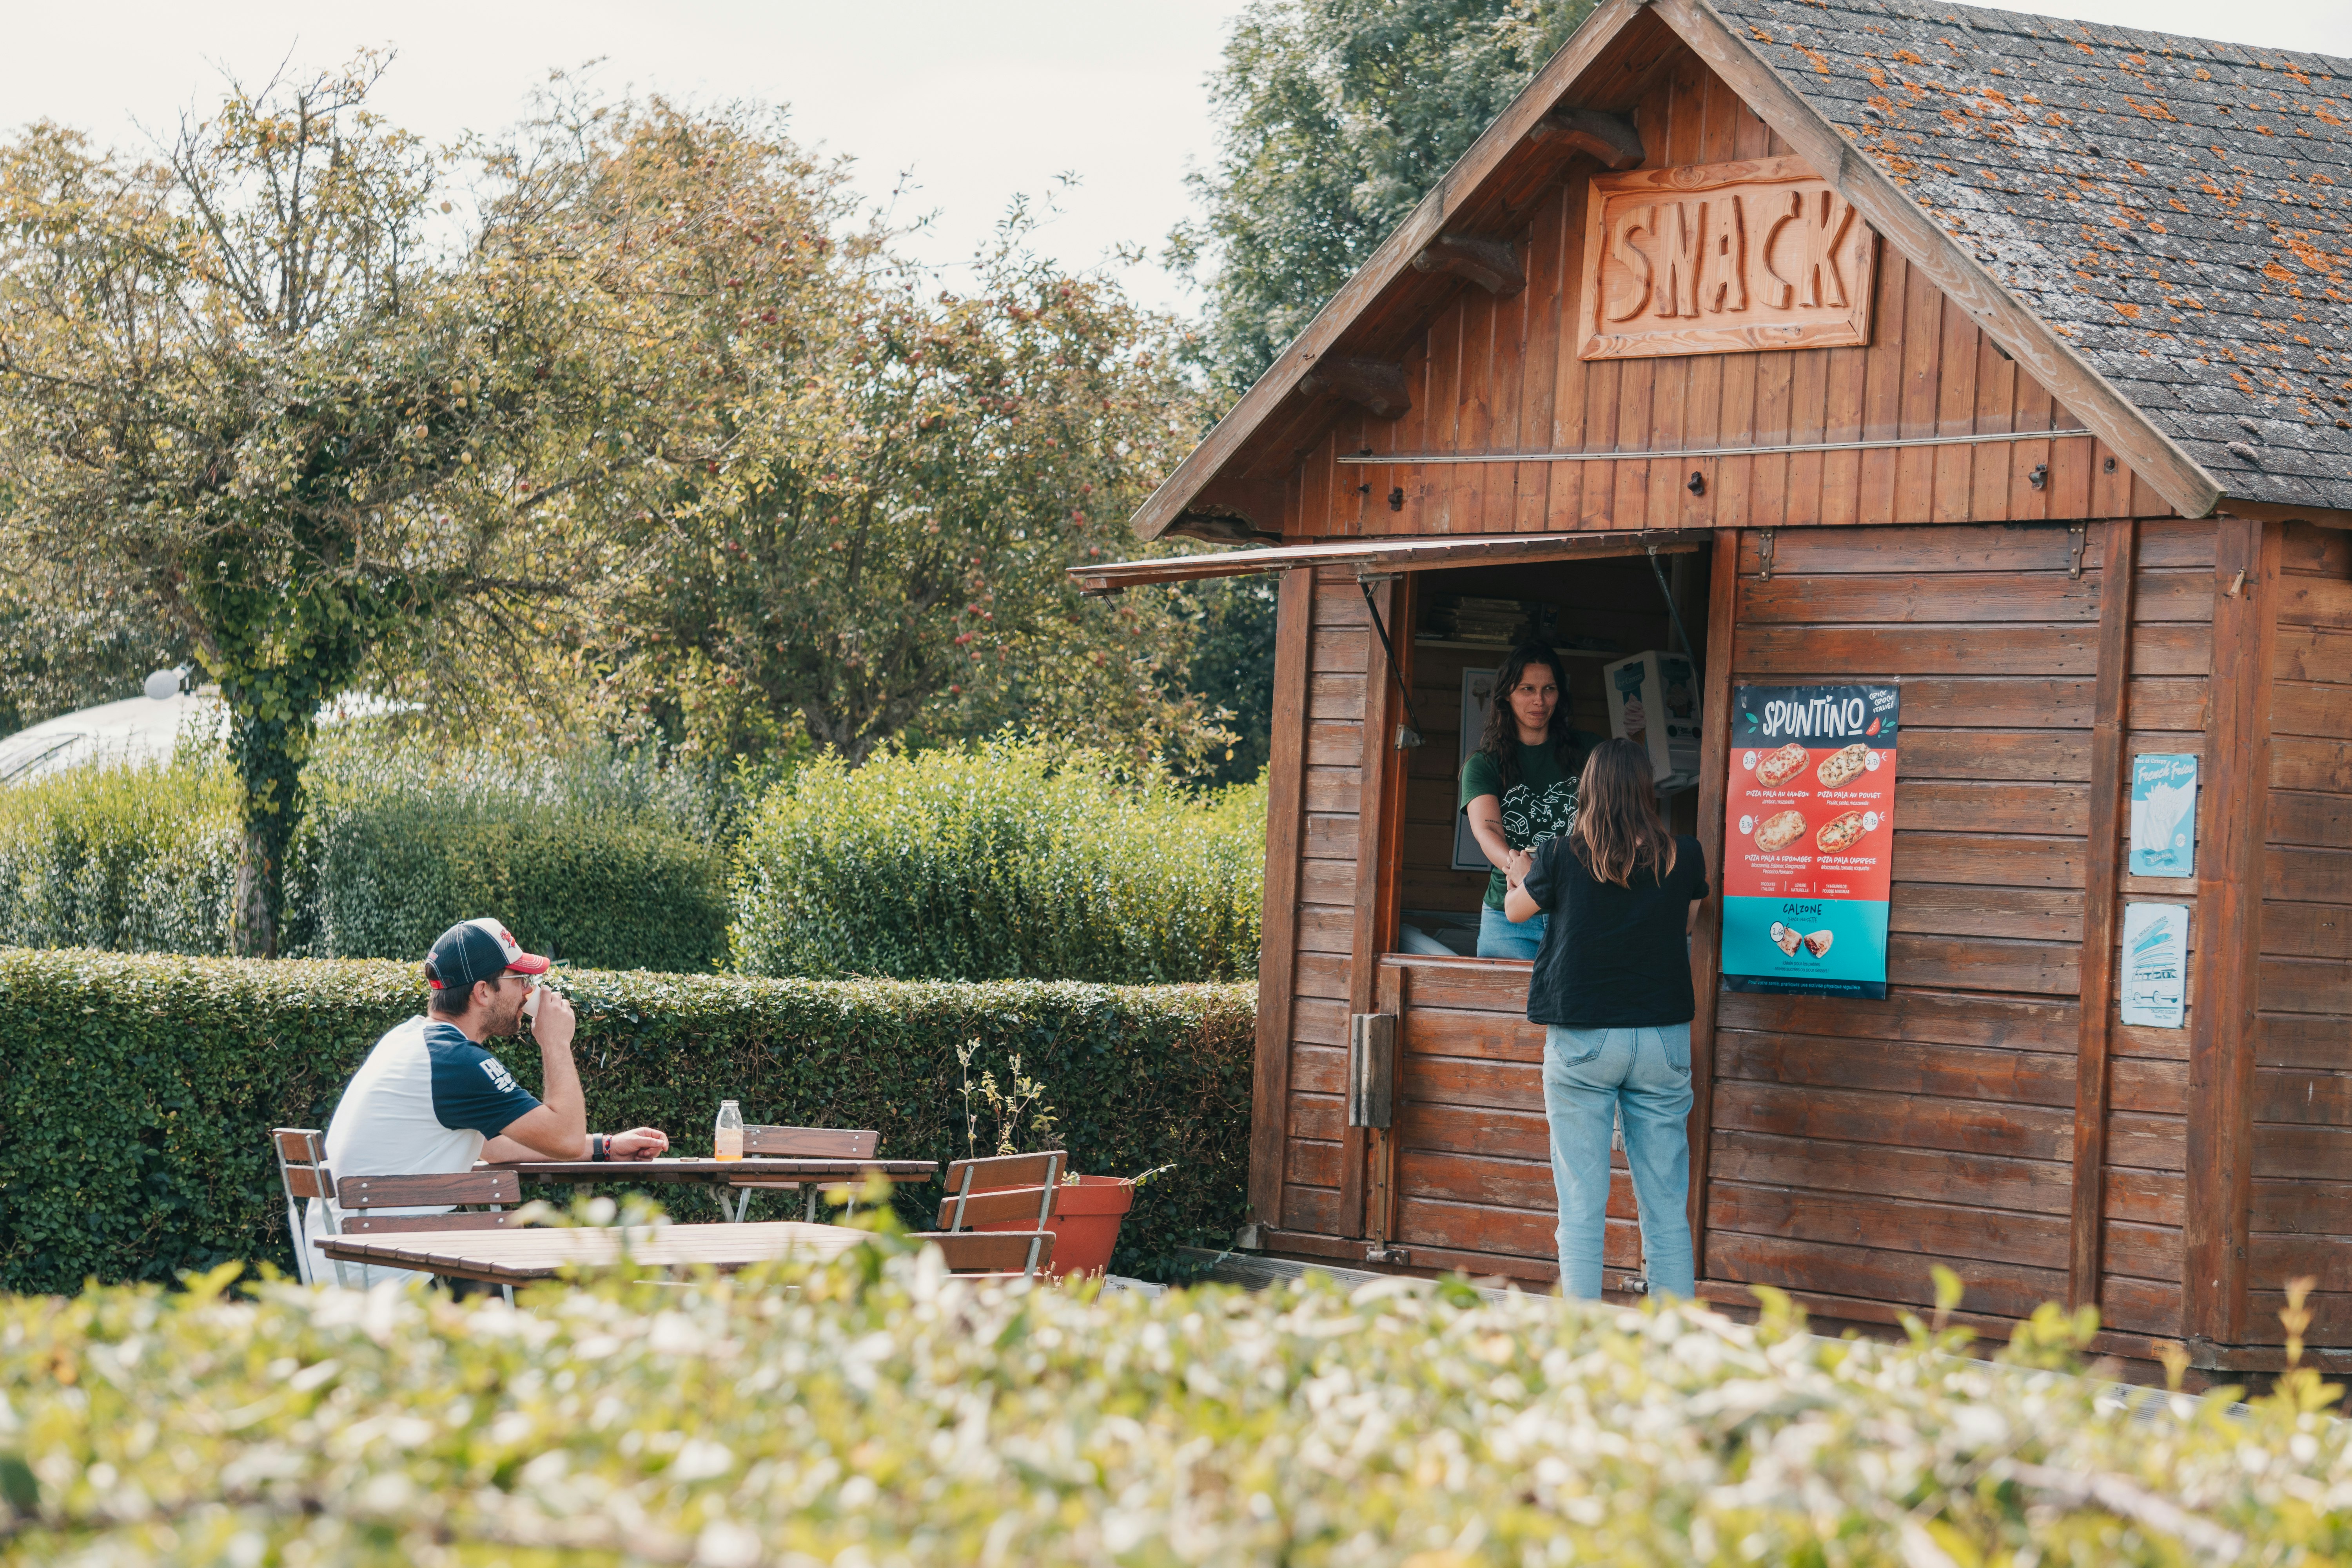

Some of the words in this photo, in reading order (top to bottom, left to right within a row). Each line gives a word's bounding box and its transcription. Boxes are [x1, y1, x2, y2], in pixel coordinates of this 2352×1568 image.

[1606, 191, 1852, 321] SNACK
[1625, 673, 1643, 684] Cream
[1869, 690, 1887, 700] CRICK
[1874, 695, 1893, 706] CROCK
[1873, 702, 1894, 713] ITALIE!
[1763, 695, 1864, 738] SPUNTINO
[2138, 761, 2171, 785] French
[2171, 761, 2194, 781] Fries
[1783, 904, 1822, 915] CALZONE
